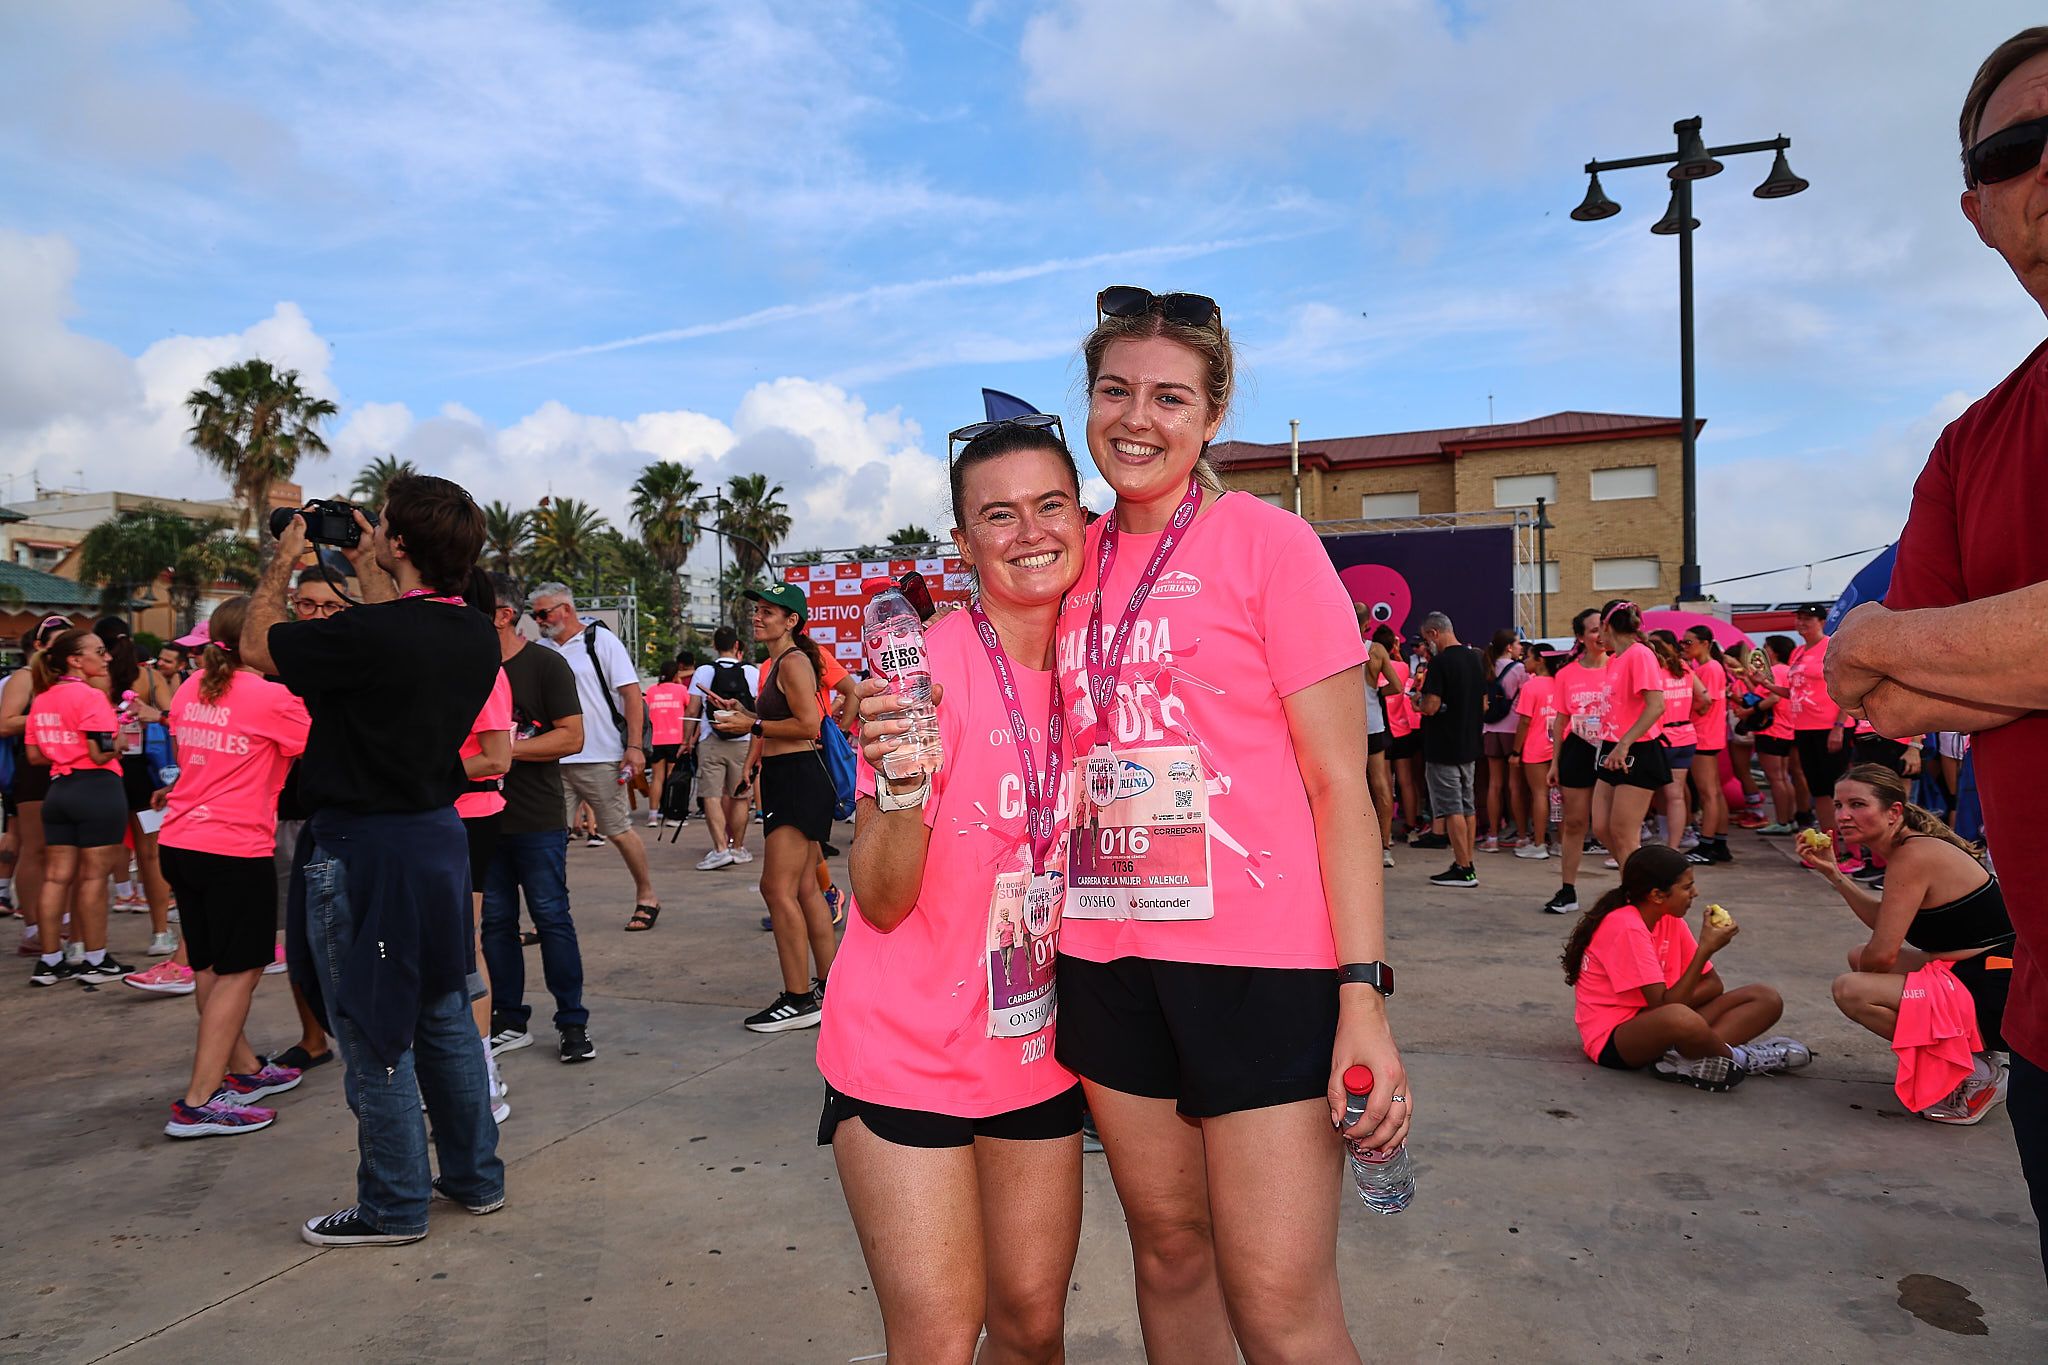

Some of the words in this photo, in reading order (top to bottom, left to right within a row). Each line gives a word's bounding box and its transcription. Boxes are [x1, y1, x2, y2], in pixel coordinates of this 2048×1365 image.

[807, 604, 860, 621] BJETIVO
[880, 647, 917, 661] ZERO
[882, 656, 920, 670] SODIO
[1116, 681, 1164, 743] DE
[176, 726, 250, 755] PARABLES
[990, 727, 1041, 746] OYO
[1089, 764, 1114, 772] MUJER
[1119, 778, 1149, 788] RIANA
[1153, 827, 1203, 836] CORREDORA
[1100, 826, 1150, 855] 016
[1112, 861, 1134, 872] 1736
[1077, 876, 1101, 886] CARRERA
[1102, 877, 1110, 885] DE
[1111, 877, 1118, 885] LA
[1120, 876, 1141, 885] MUJER
[1149, 875, 1190, 885] VALENCIA
[999, 886, 1027, 900] SUMA
[1028, 892, 1051, 904] MUJER
[1079, 895, 1116, 908] OYSHO
[1138, 897, 1191, 909] Santander
[1034, 931, 1059, 965] 01
[1008, 990, 1038, 1005] CARRERA
[1038, 986, 1044, 996] DE
[1902, 988, 1926, 999] UJER
[1009, 1003, 1047, 1026] OYSHO
[1021, 1034, 1046, 1064] 2026
